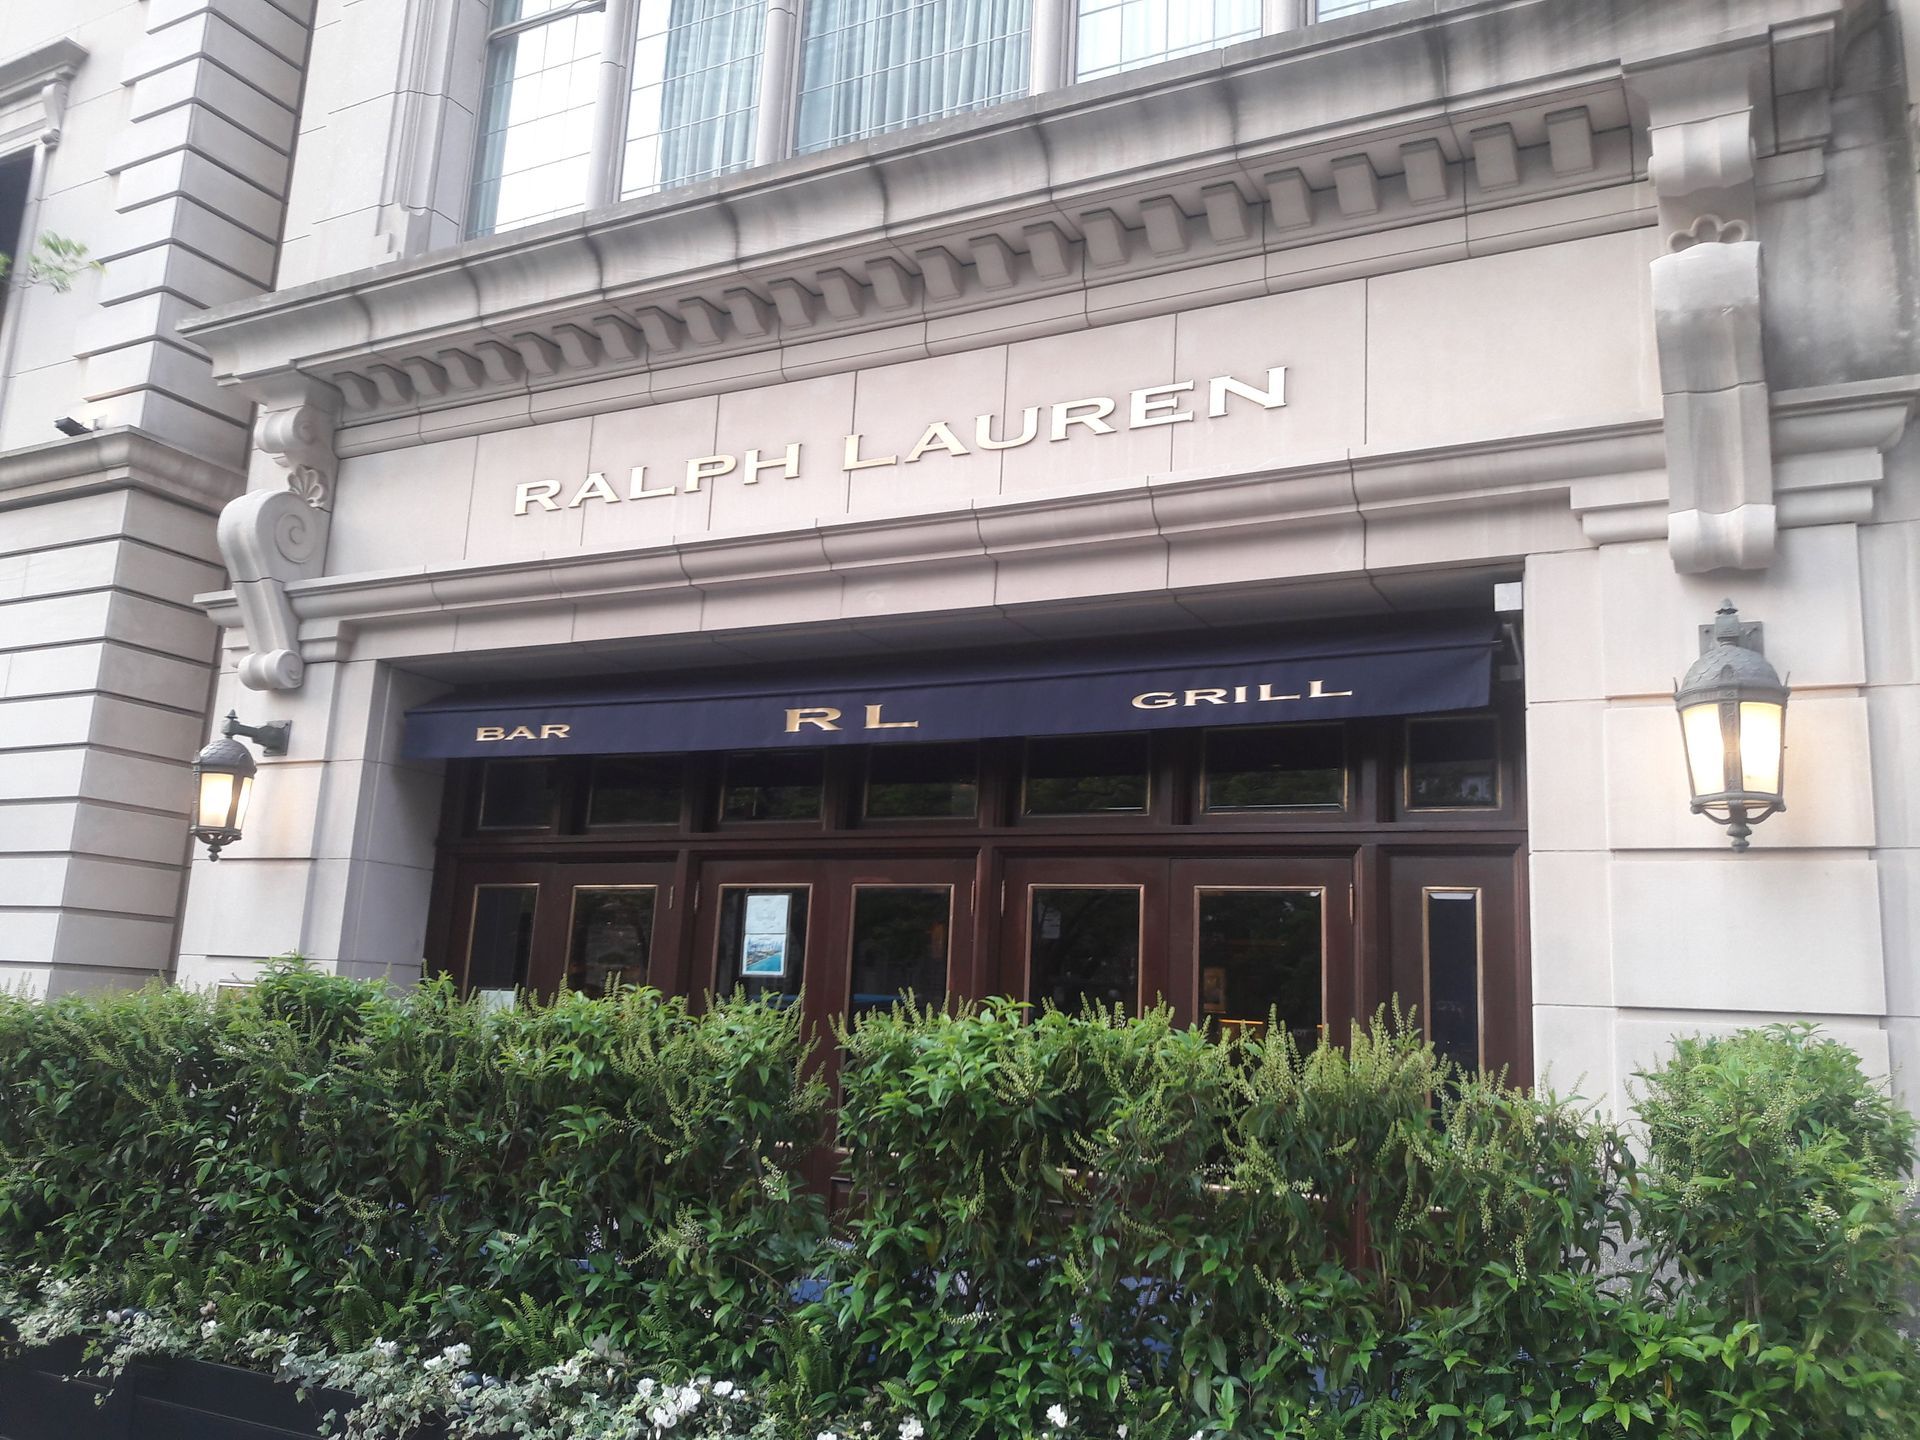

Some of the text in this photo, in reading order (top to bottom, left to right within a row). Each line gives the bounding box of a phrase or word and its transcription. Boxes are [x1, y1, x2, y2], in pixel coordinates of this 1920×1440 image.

[514, 366, 1288, 515] RALPH LAUREN
[1131, 680, 1353, 709] GRILL
[475, 724, 571, 742] BAR
